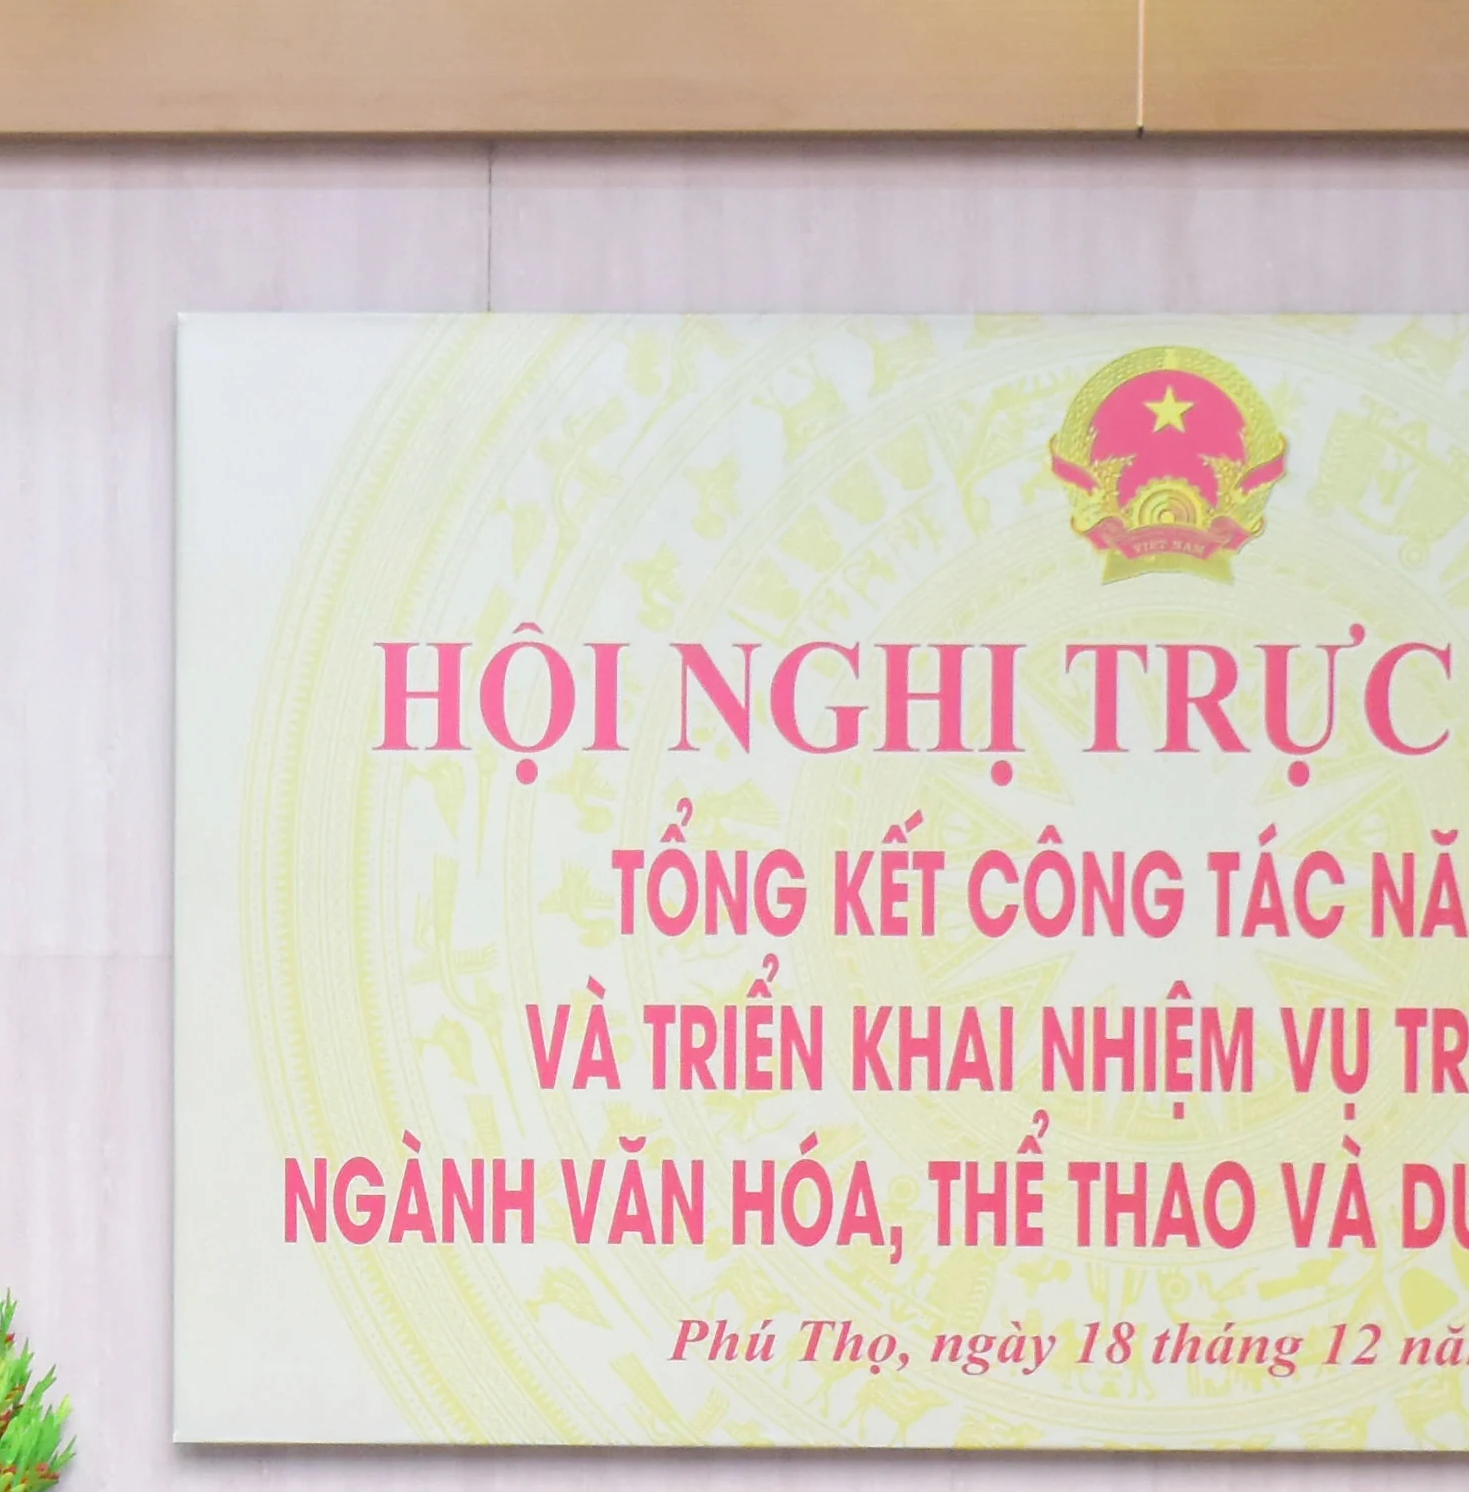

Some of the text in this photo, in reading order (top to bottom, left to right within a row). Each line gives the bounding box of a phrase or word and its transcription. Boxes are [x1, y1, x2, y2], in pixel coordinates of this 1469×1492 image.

[373, 623, 628, 785] HỘI
[668, 642, 1026, 789] NGHỊ
[1063, 624, 1452, 788] TRỰC
[612, 799, 807, 938] TỔNG
[835, 812, 945, 937] KẾT
[969, 825, 1185, 938] CÔNG
[1208, 824, 1345, 938] TÁC
[526, 976, 621, 1090] VÀ
[644, 953, 823, 1091] TRIỂN
[853, 1006, 1014, 1092] KHAI
[1034, 980, 1254, 1120] NHIỆM
[1281, 1007, 1371, 1121] VỤ
[285, 1132, 535, 1244] NGÀNH
[562, 1136, 704, 1245] VĂN
[733, 1134, 903, 1264] HÓA,
[929, 1108, 1050, 1247] THỂ
[1068, 1160, 1256, 1249] THAO
[1281, 1133, 1376, 1249] VÀ
[671, 1320, 775, 1362] Phú
[801, 1320, 911, 1375] Thọ,
[930, 1320, 1057, 1375] ngày
[1078, 1322, 1137, 1364] 18
[1152, 1323, 1302, 1376] tháng
[1325, 1324, 1383, 1366] 12
